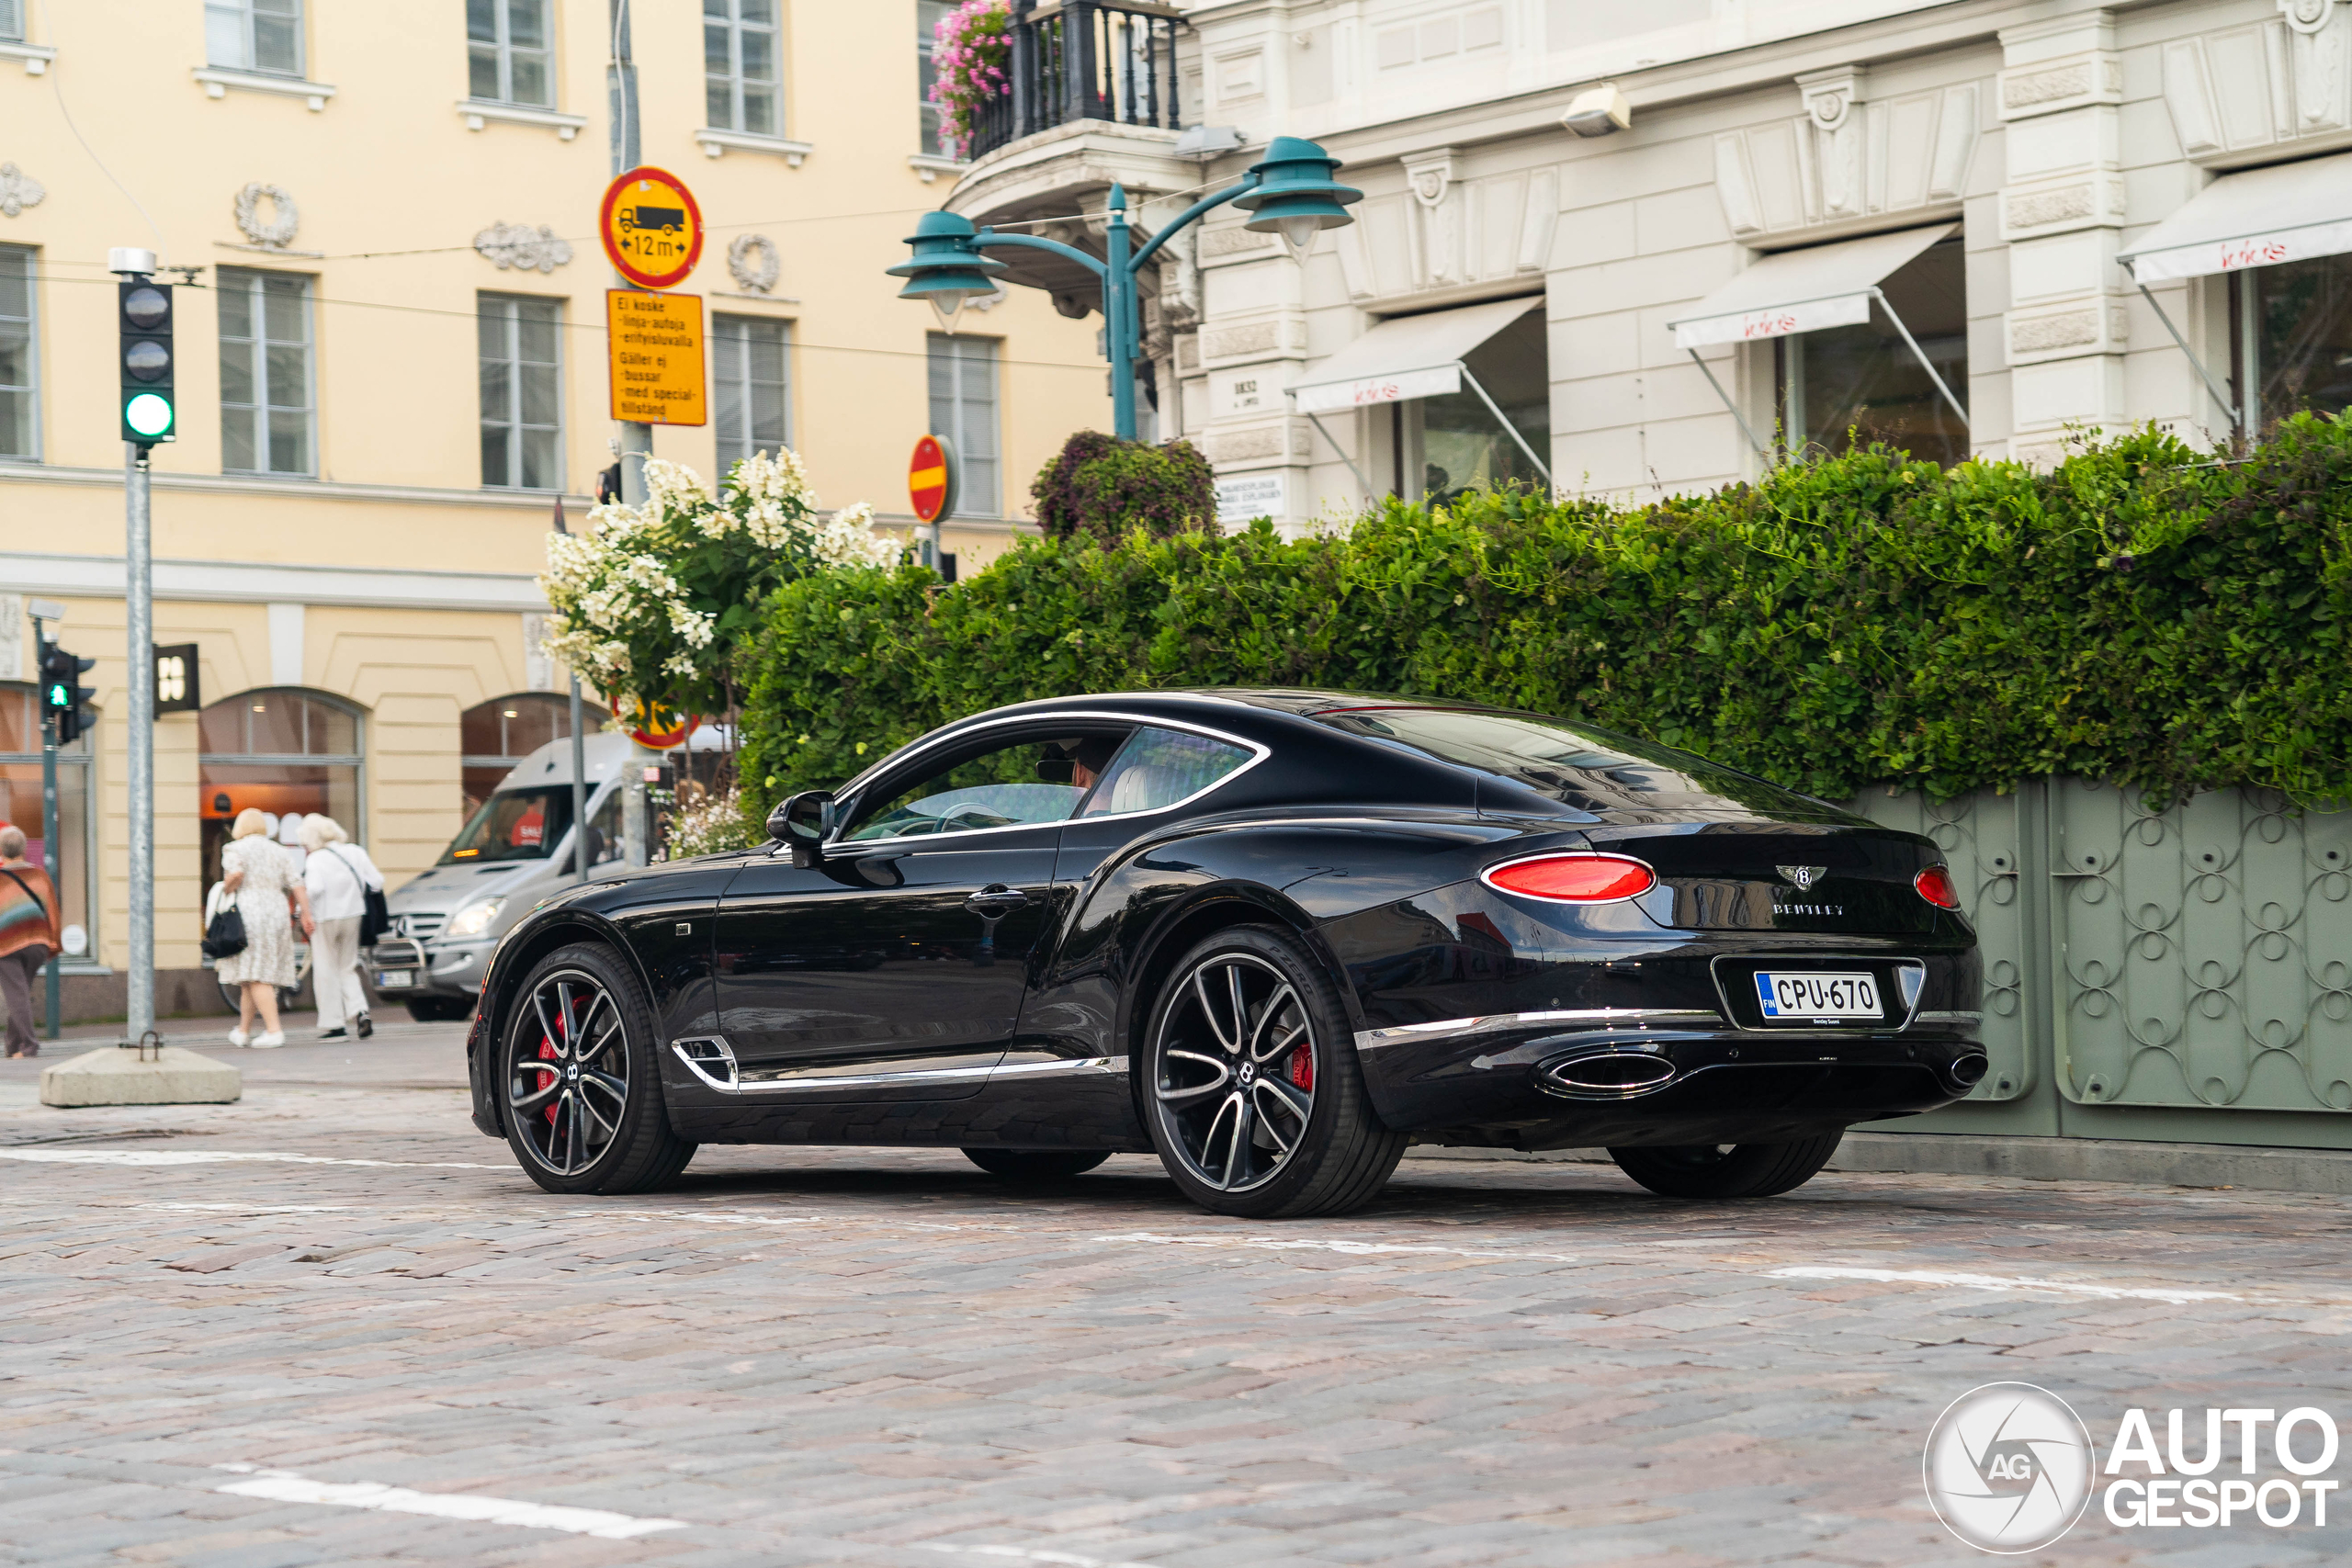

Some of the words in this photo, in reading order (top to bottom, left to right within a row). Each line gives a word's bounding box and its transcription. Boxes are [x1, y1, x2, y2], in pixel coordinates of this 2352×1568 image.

[617, 297, 628, 310] Ei
[634, 299, 665, 312] koske
[619, 351, 652, 366] Gäller
[657, 354, 667, 367] ej
[1799, 870, 1810, 885] B
[1773, 904, 1843, 916] BENTLEY
[1279, 953, 1314, 995] ZERO
[1777, 979, 1875, 1010] CPU-670
[1762, 999, 1776, 1010] FIN
[688, 1042, 707, 1057] 12
[1240, 1063, 1255, 1083] B
